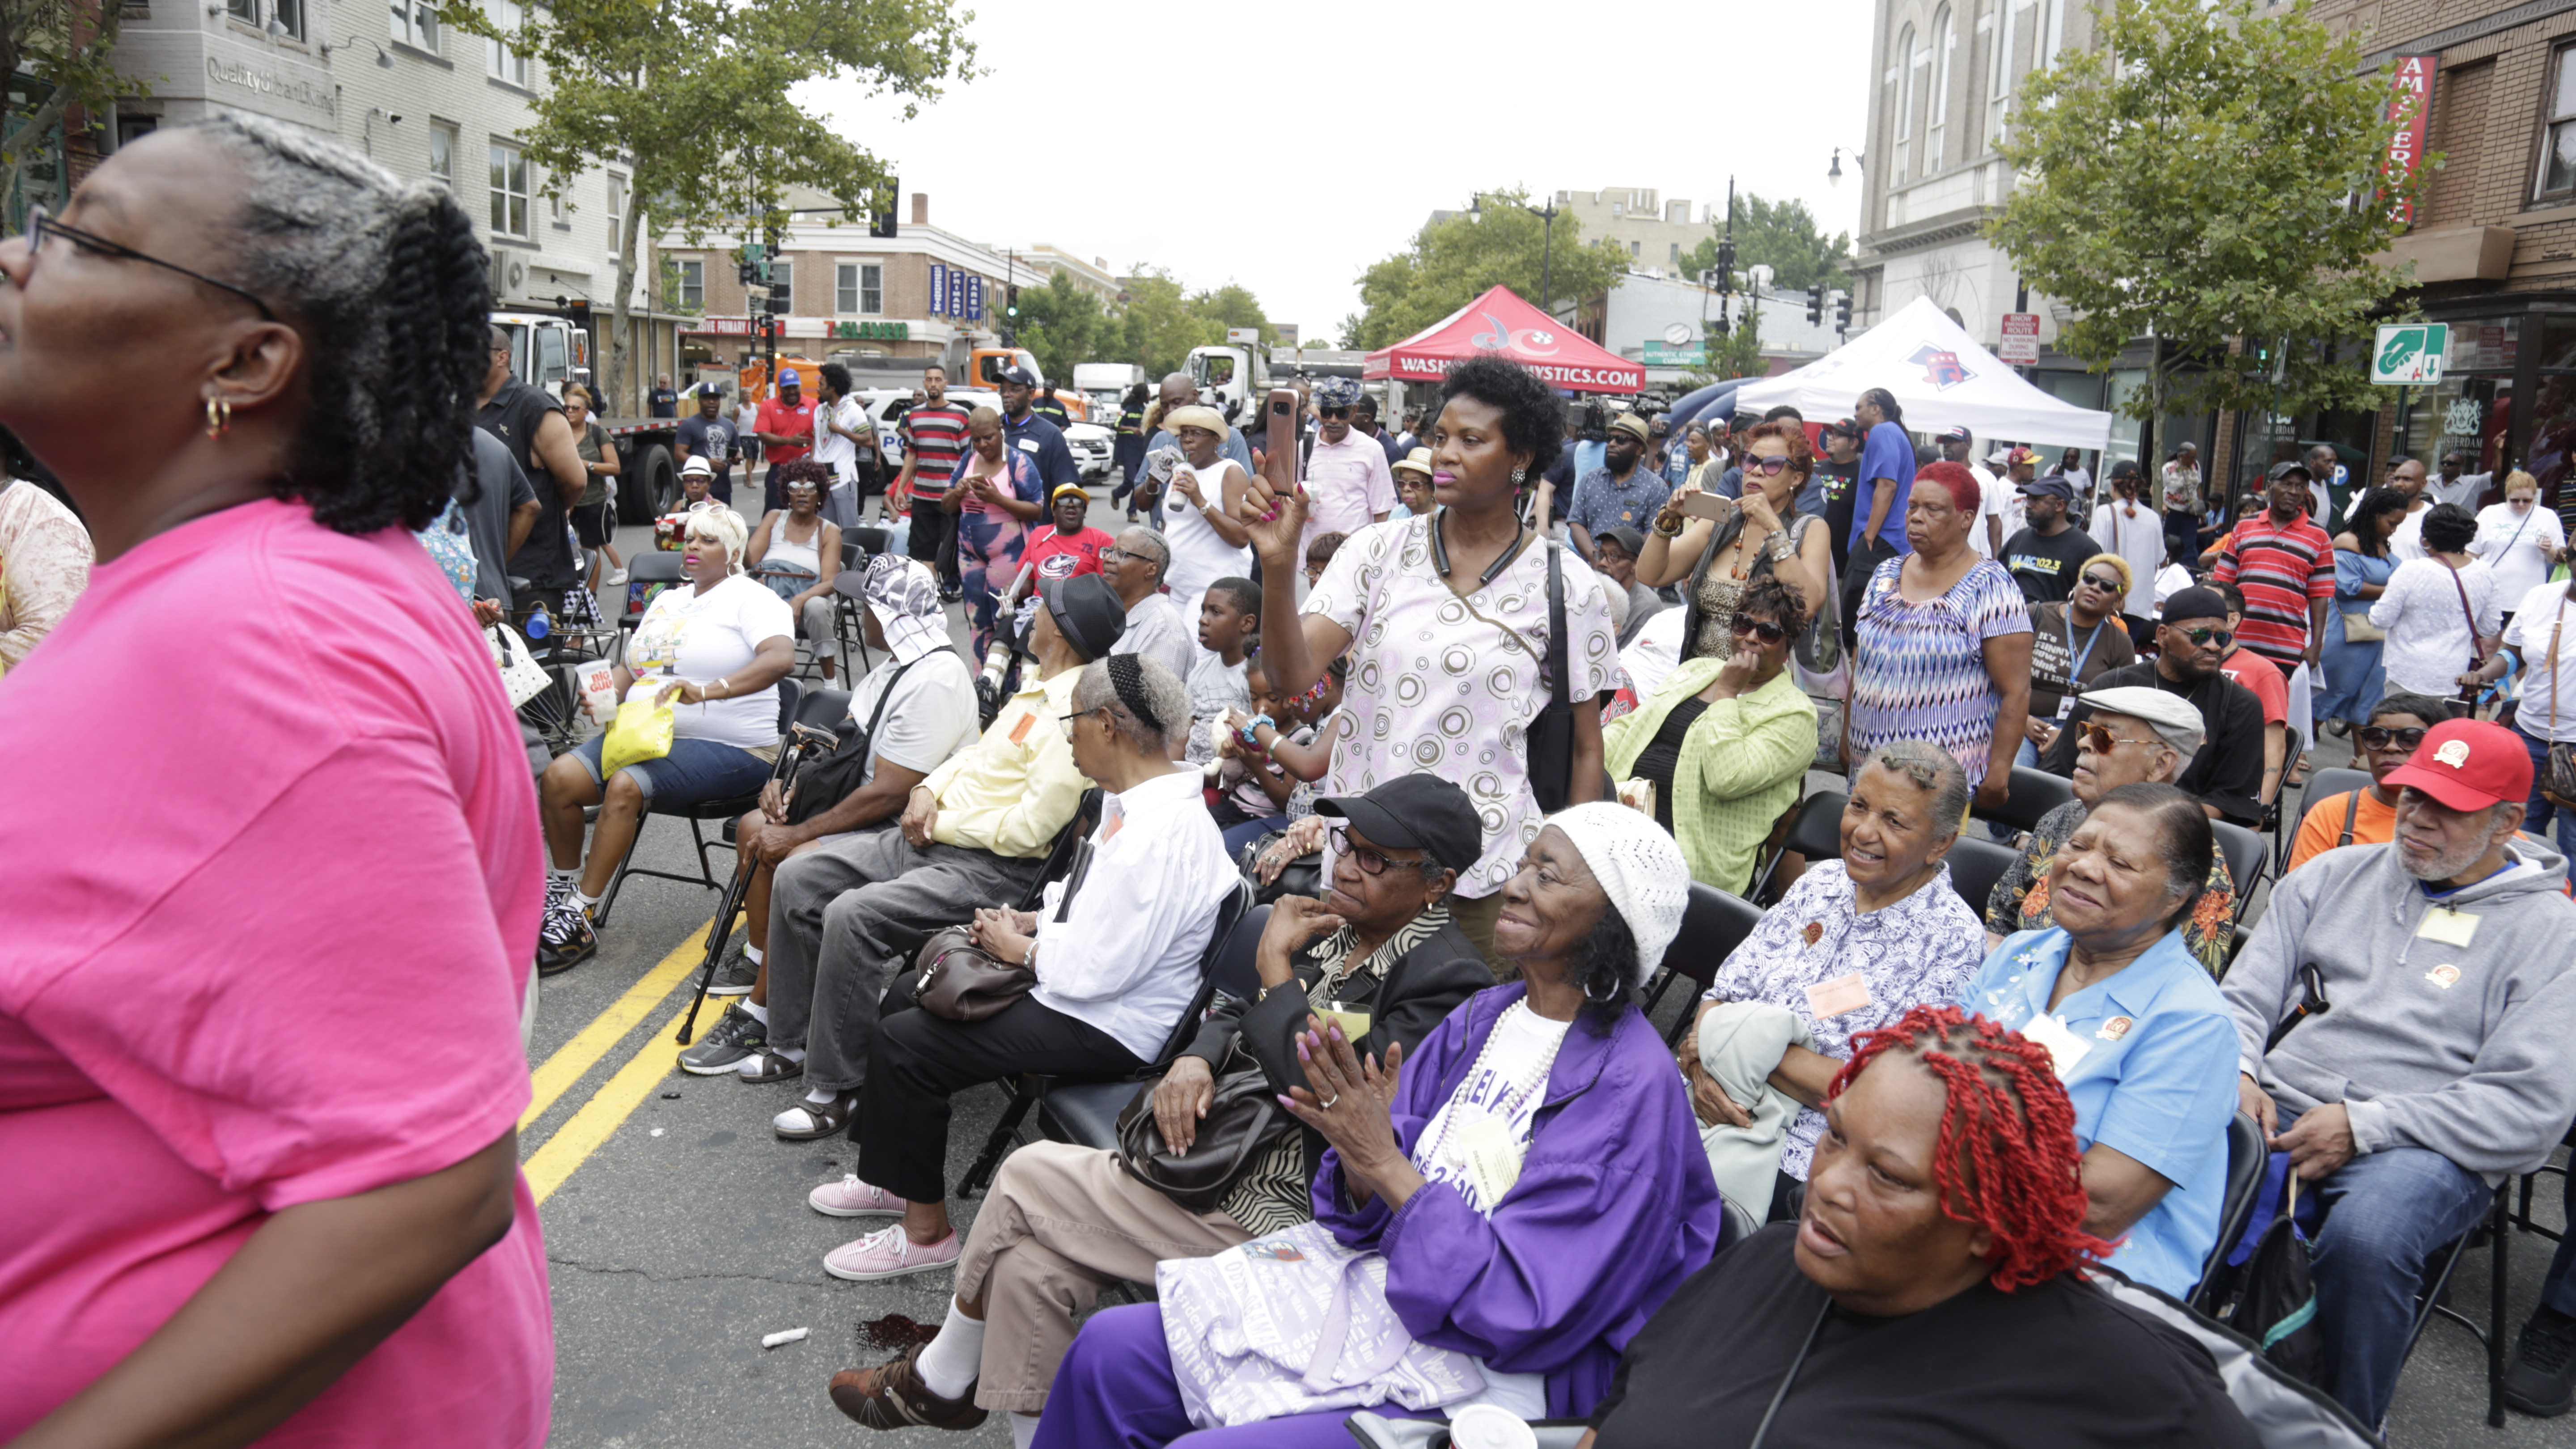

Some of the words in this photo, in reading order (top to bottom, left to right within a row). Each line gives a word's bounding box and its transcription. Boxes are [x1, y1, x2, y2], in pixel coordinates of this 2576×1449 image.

[952, 272, 961, 315] PRIMARY
[970, 277, 978, 305] CARE
[717, 319, 747, 334] PRIMARY
[2262, 425, 2295, 435] AMERDAM
[2334, 466, 2346, 484] P
[589, 679, 613, 693] GULP
[591, 670, 610, 685] BIG
[1473, 1150, 1486, 1180] DELORIS
[1484, 1181, 1494, 1203] KILGO
[1167, 1326, 1216, 1386] STATES
